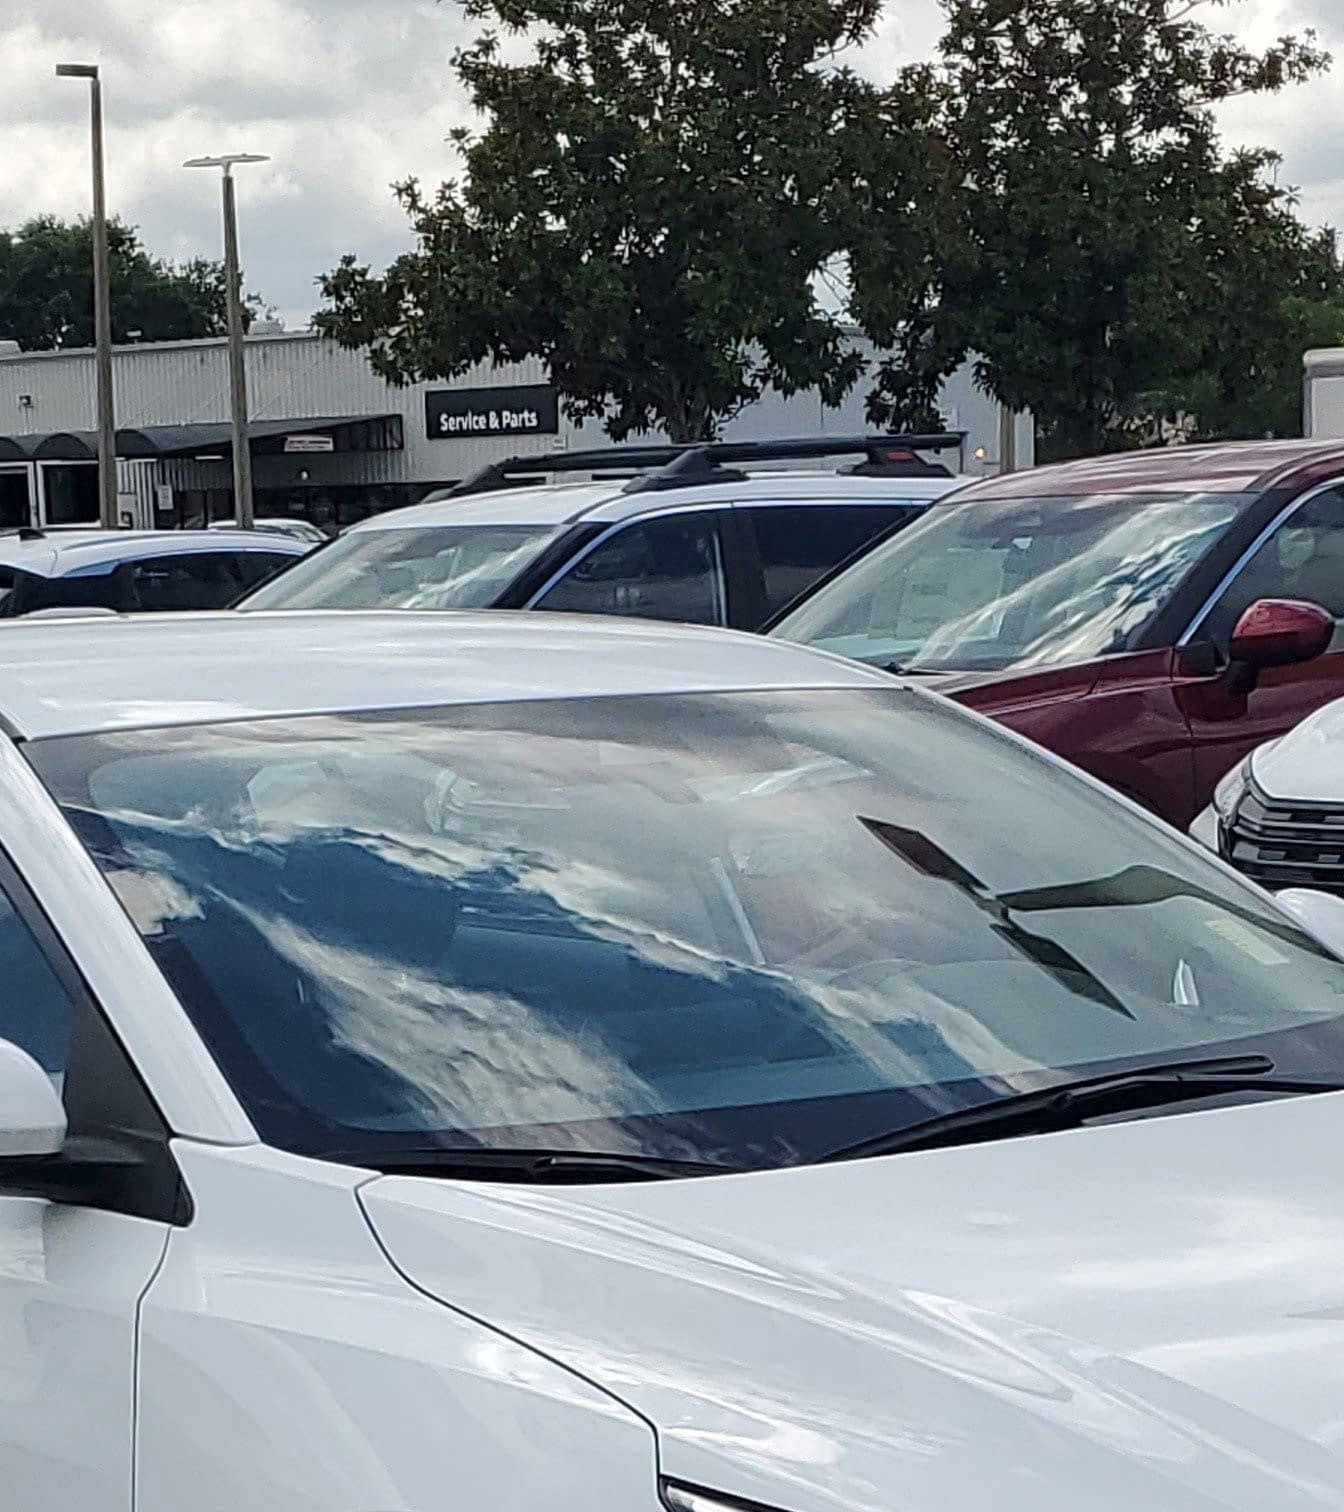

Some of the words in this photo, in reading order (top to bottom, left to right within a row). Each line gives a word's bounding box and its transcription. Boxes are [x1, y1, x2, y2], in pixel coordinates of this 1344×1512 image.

[440, 410, 486, 432] Service
[488, 411, 500, 431] &
[502, 409, 539, 429] Parts
